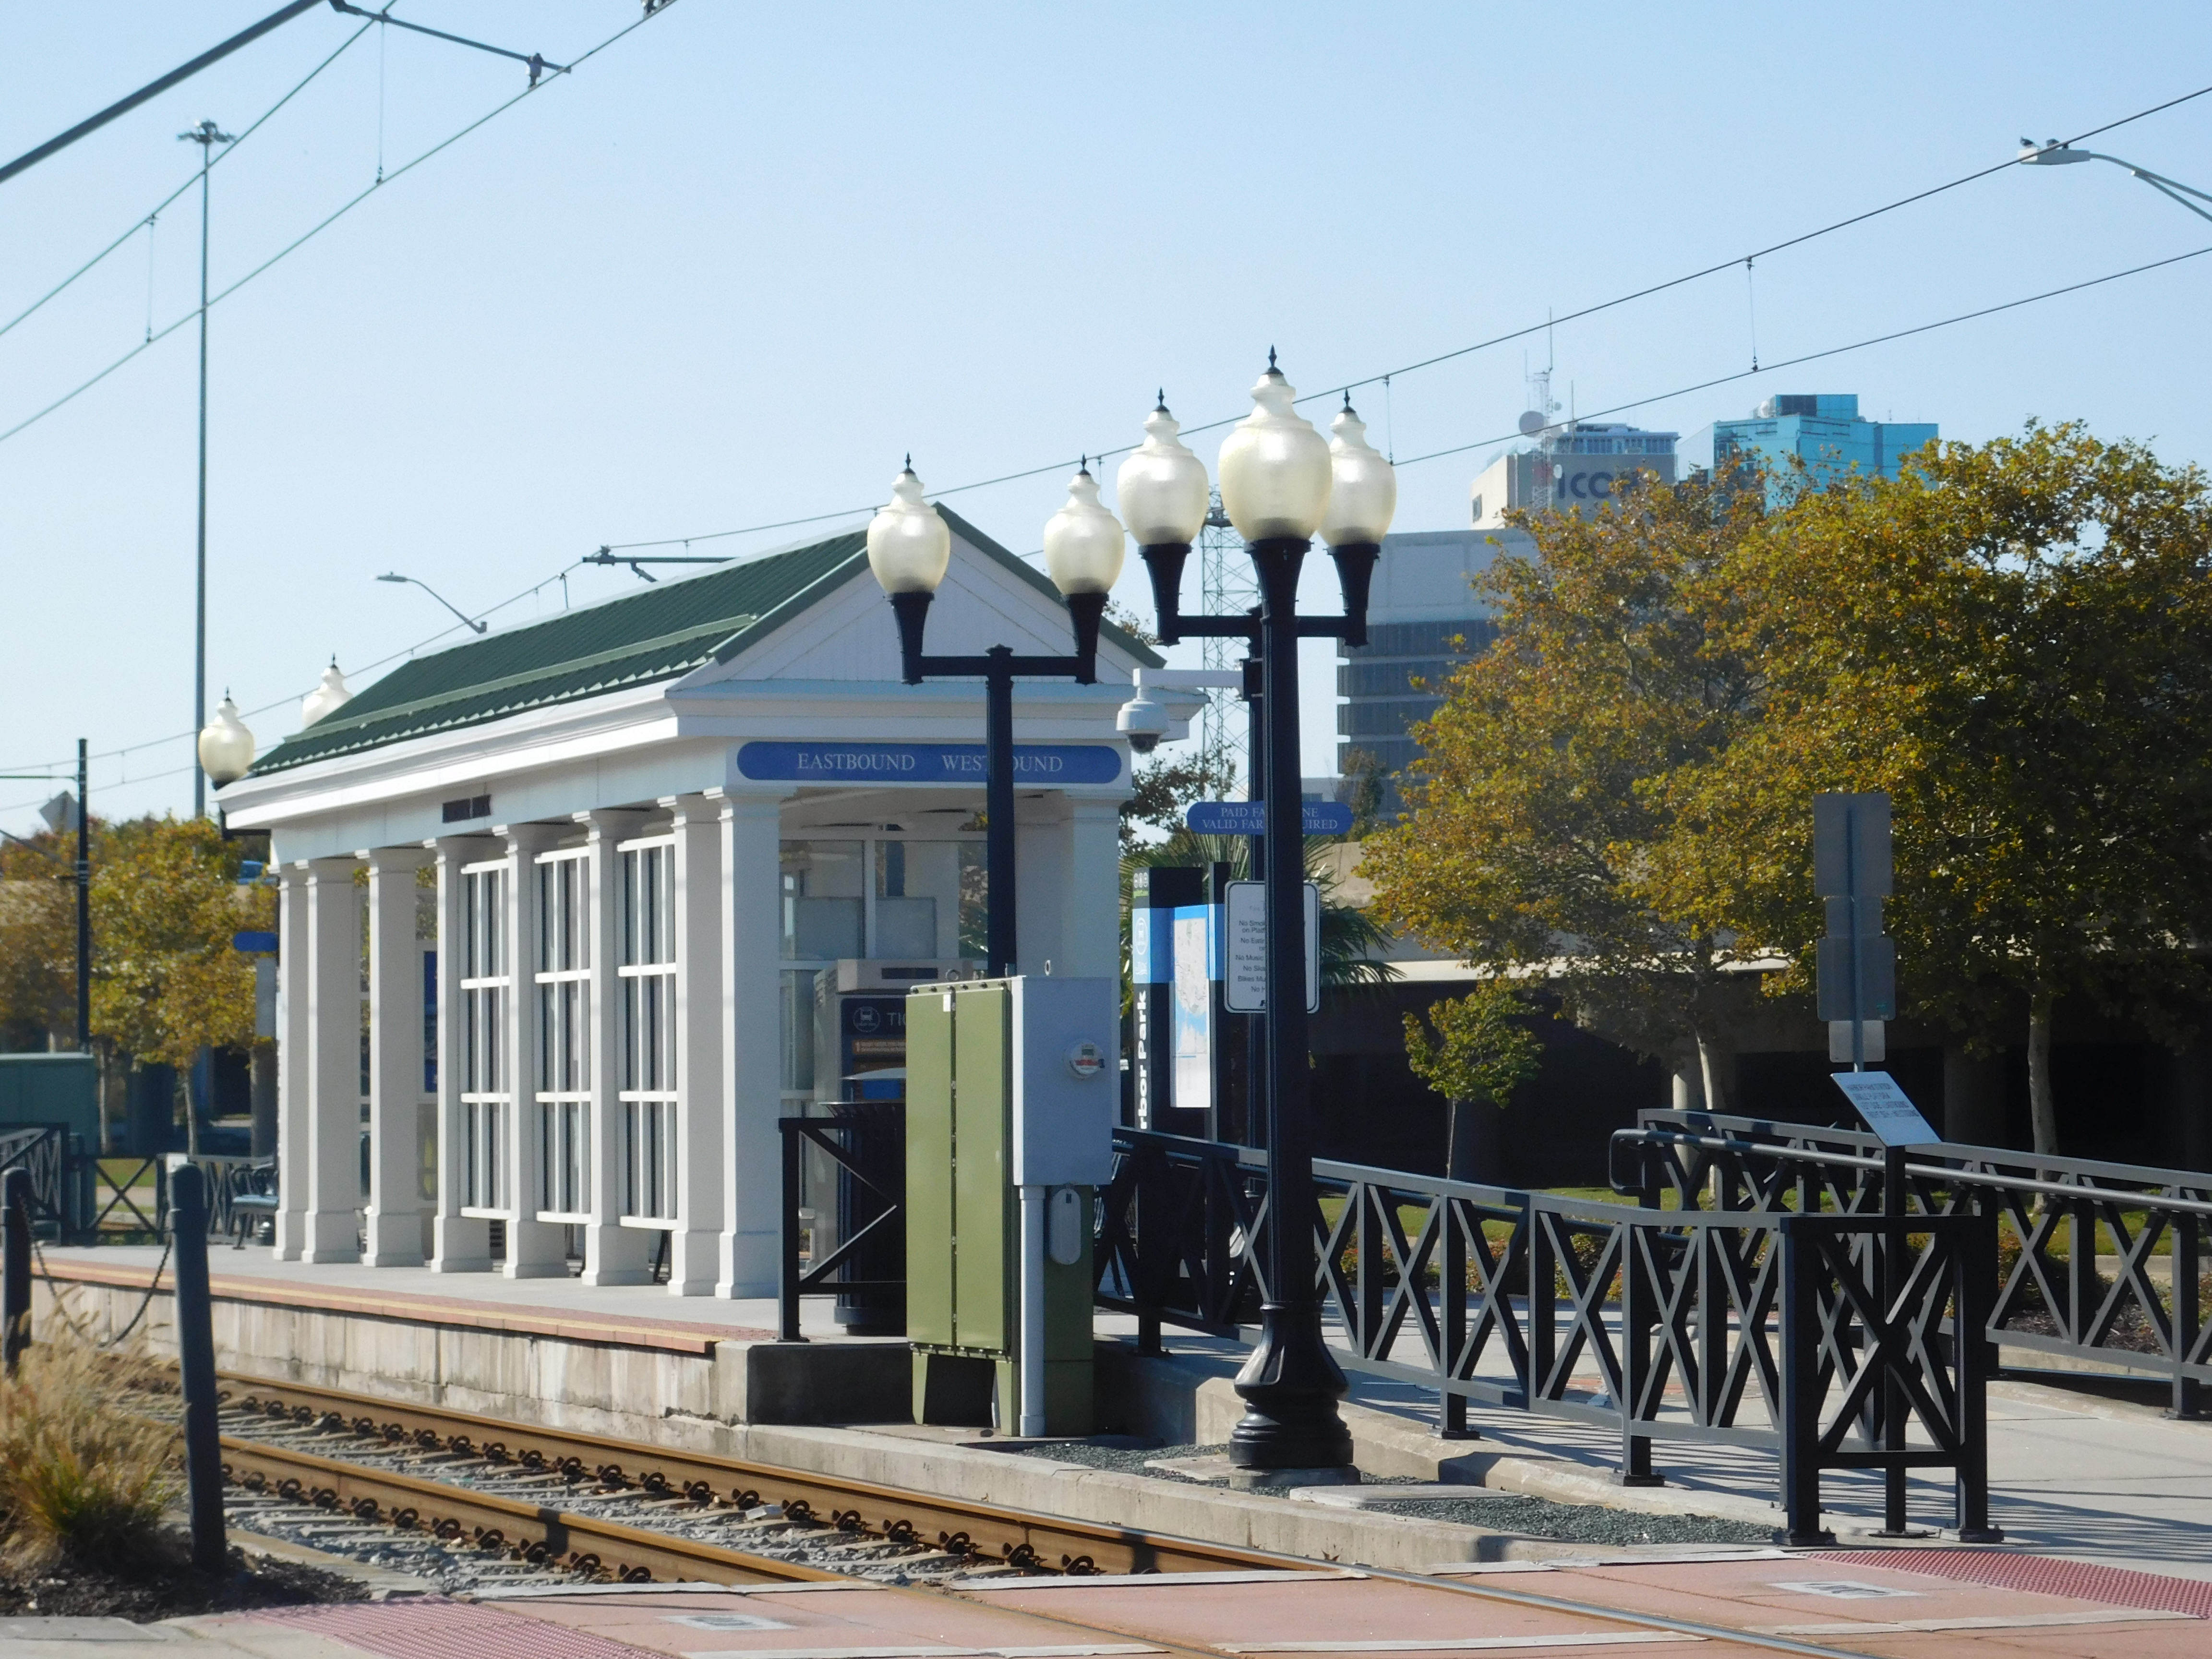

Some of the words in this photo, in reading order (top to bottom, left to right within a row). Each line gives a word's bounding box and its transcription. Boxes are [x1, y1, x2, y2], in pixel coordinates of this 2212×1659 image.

[798, 753, 915, 770] EASTBOUND
[942, 755, 1064, 772] WESUND
[1221, 807, 1248, 817] PAID
[1252, 807, 1265, 817] FA
[1302, 807, 1318, 817] NE
[1202, 819, 1237, 829] VALID
[1242, 819, 1264, 829] FAR
[1302, 819, 1338, 830] UIRED
[1137, 990, 1147, 1059] Park
[1138, 1065, 1147, 1129] rbor
